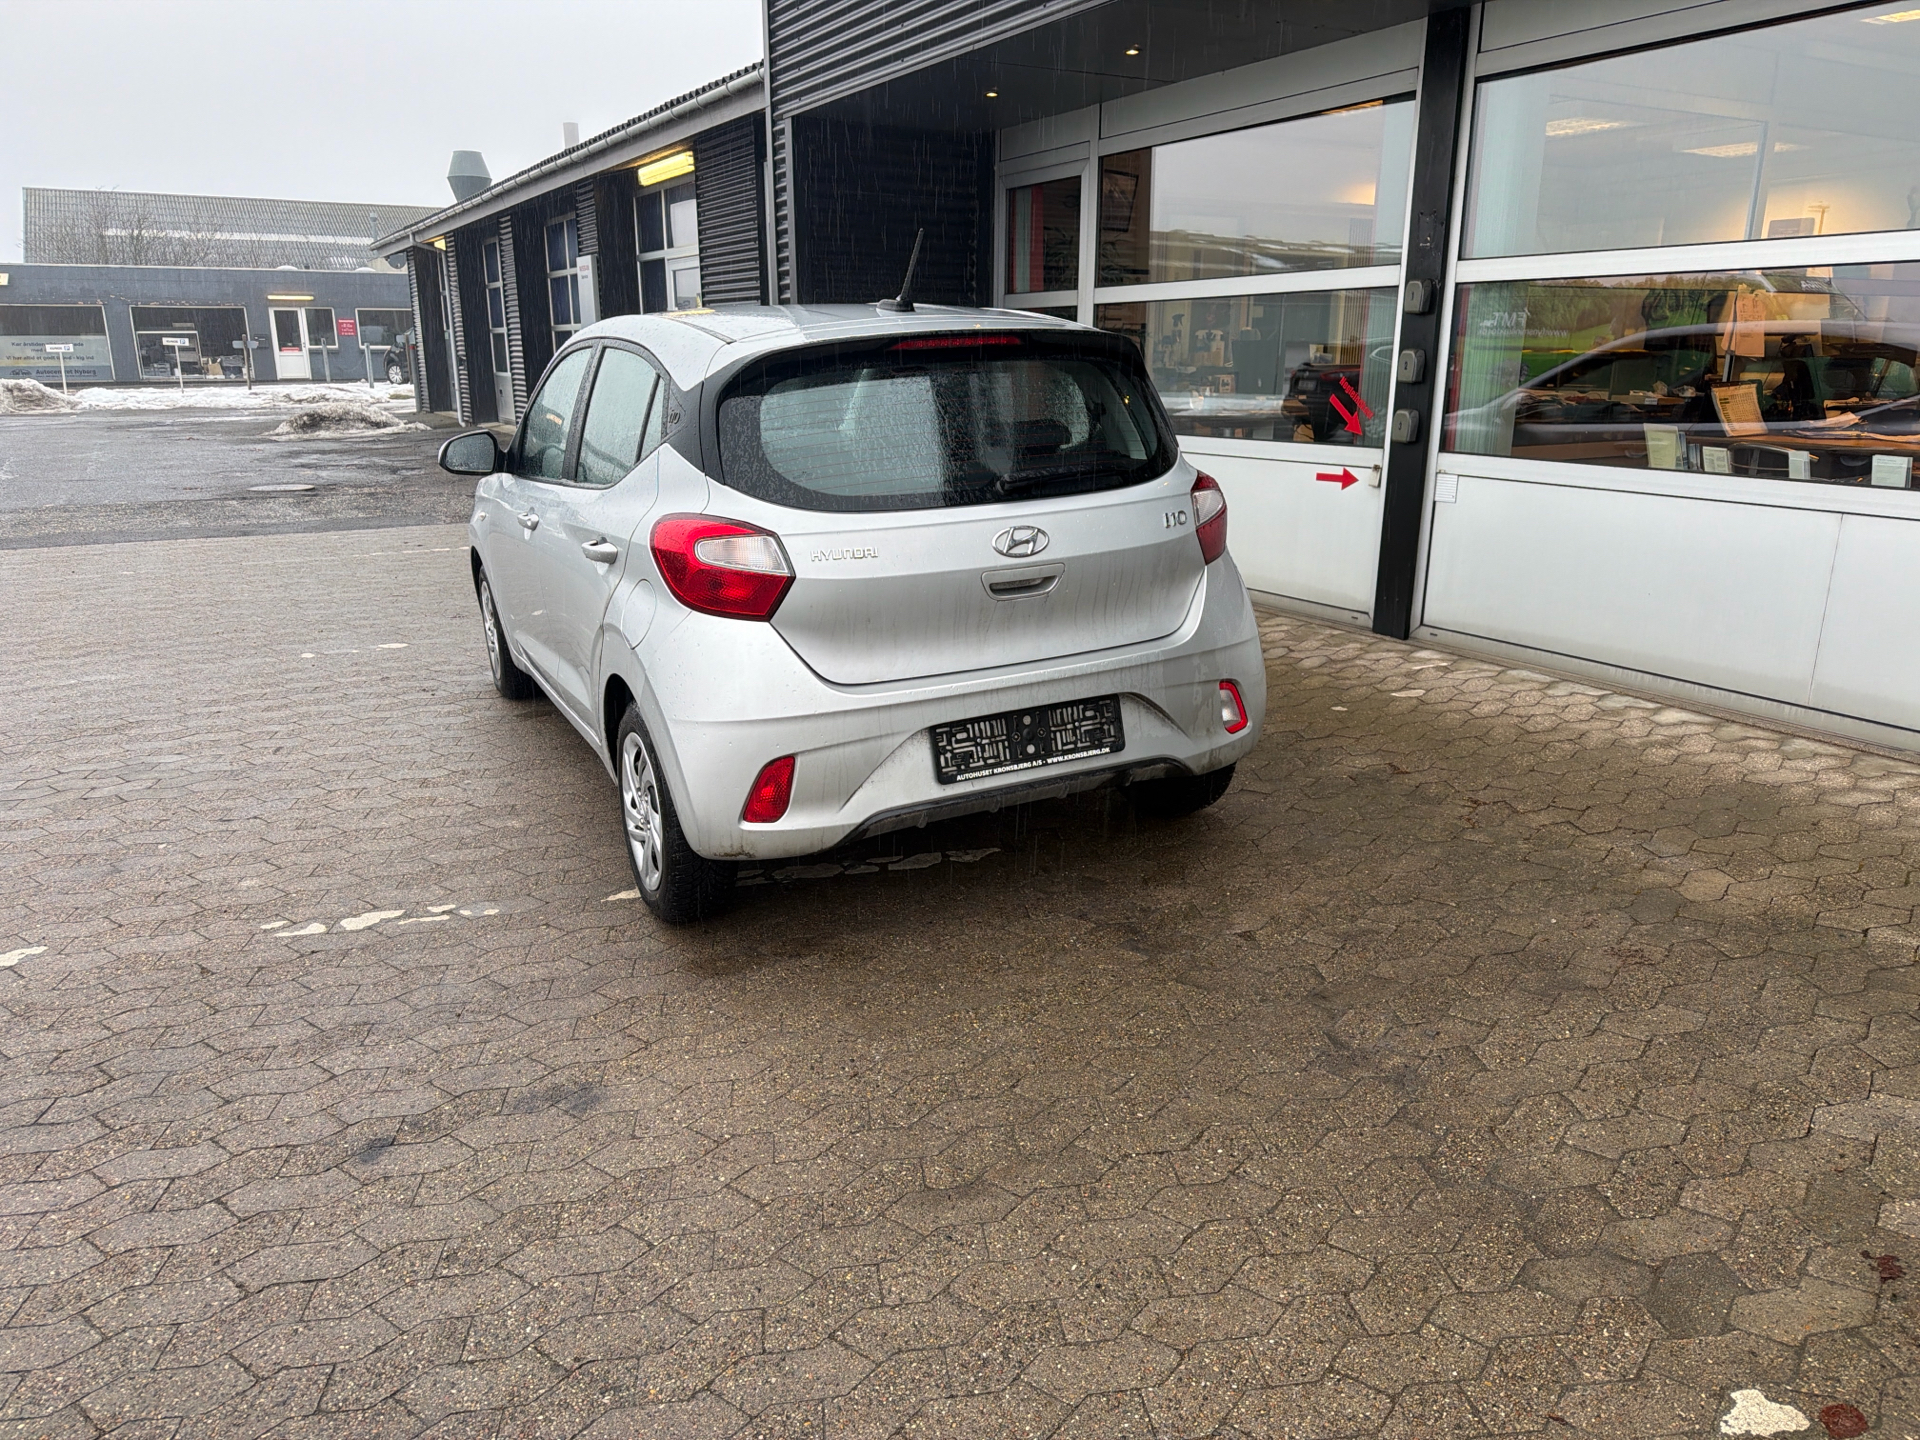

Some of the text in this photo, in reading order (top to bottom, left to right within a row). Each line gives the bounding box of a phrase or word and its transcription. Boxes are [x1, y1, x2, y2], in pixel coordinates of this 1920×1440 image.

[810, 546, 879, 562] HYUNDAI
[956, 747, 1110, 781] AUTOHUSET KRONSBJERG A/S WWW.KRONSBJERG.DK
